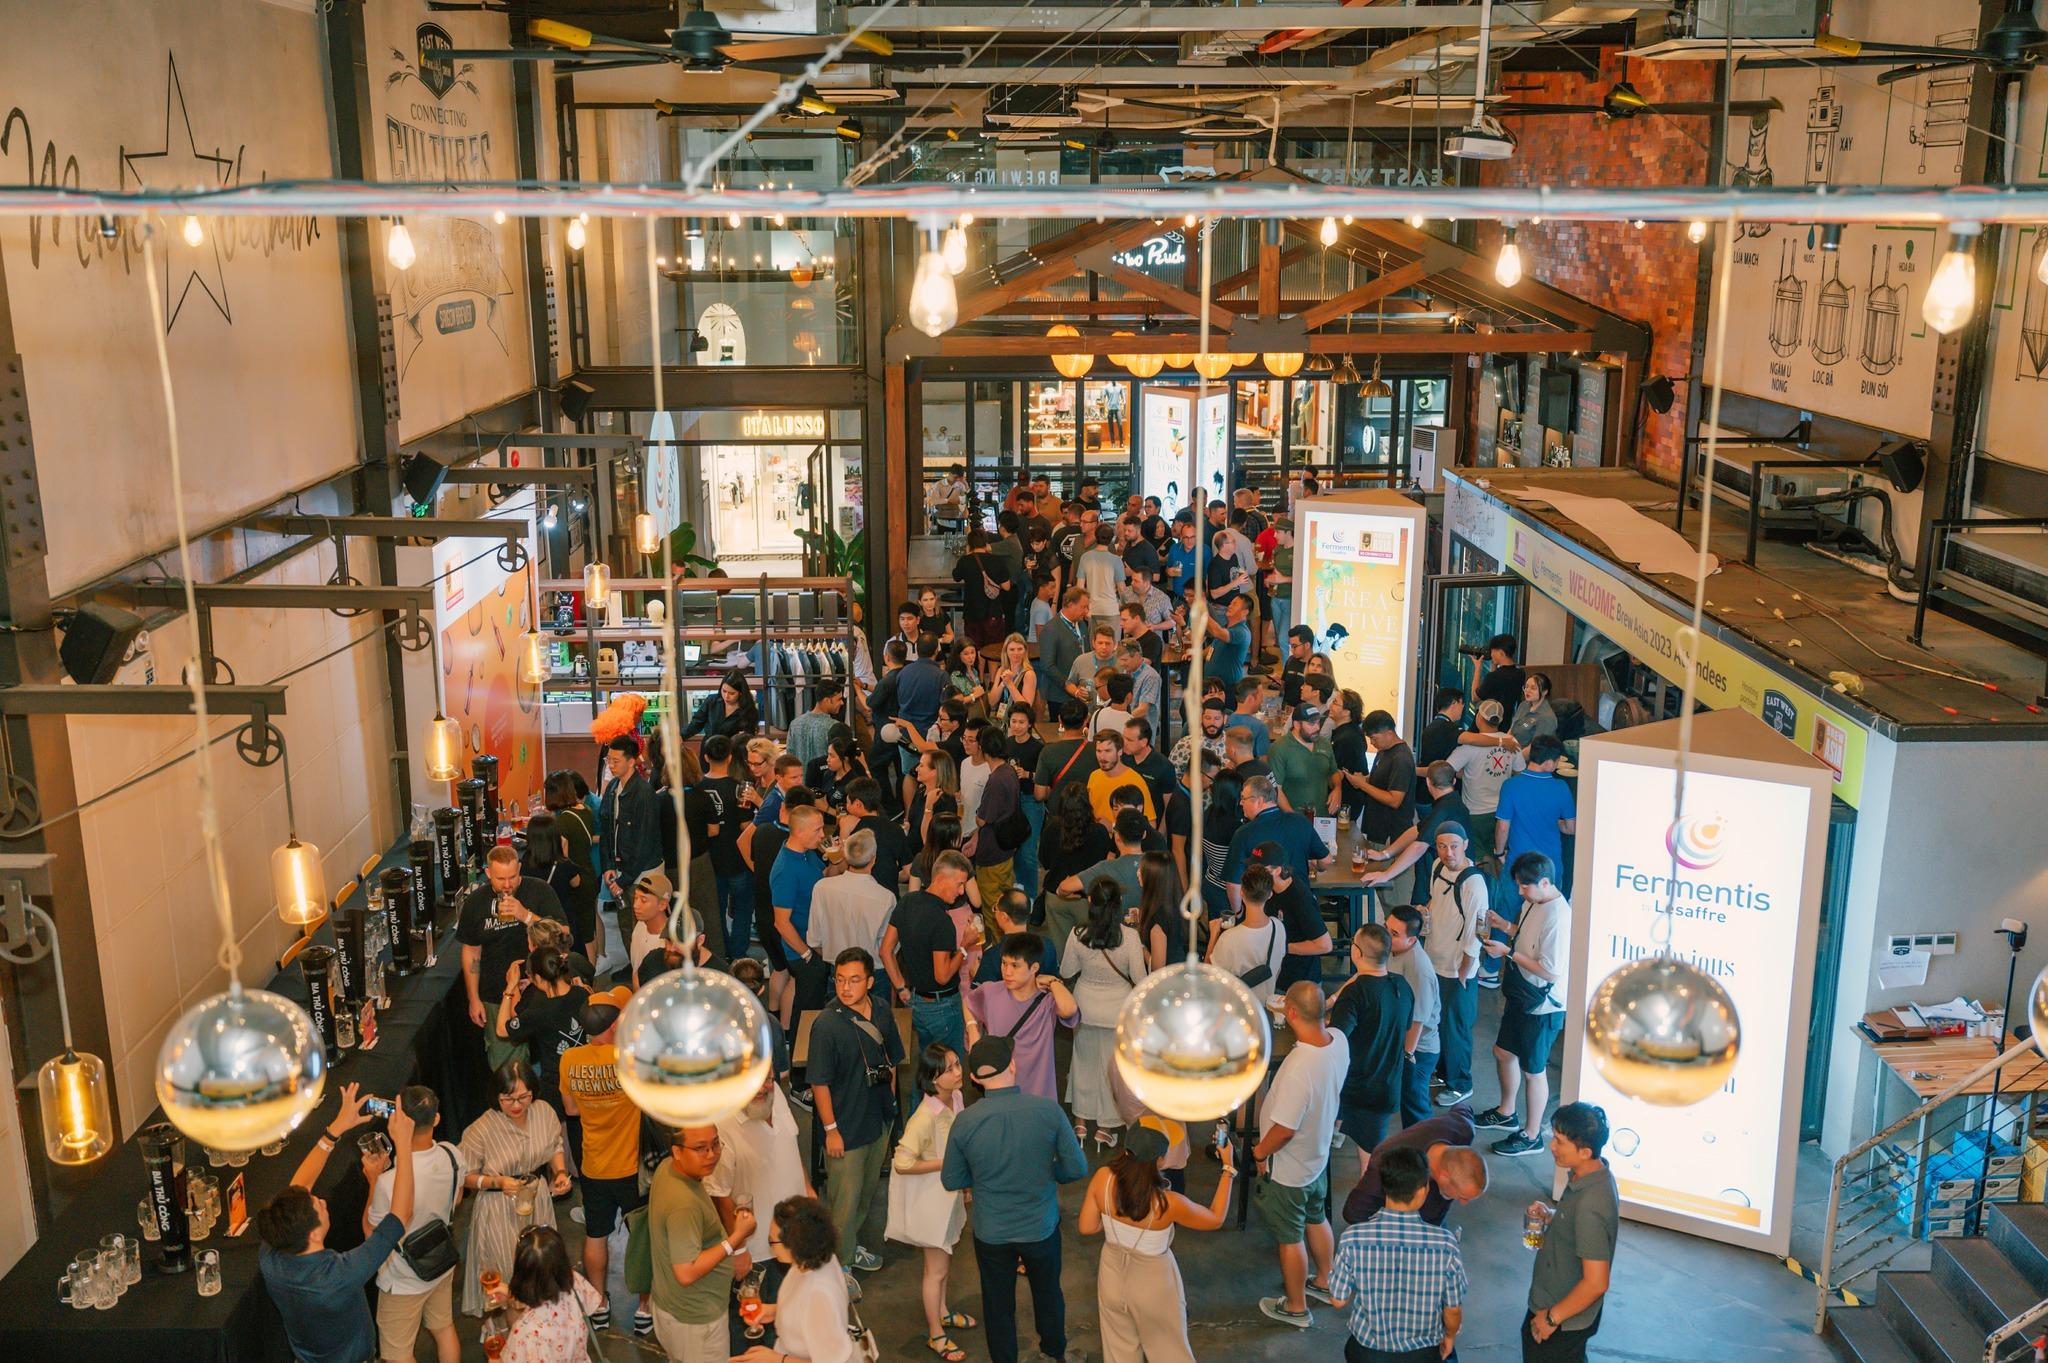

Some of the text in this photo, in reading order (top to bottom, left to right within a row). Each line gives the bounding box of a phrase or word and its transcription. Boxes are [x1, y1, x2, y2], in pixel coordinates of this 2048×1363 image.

[410, 103, 468, 128] CONNECTING
[385, 114, 492, 188] CULTURES
[1839, 137, 1853, 152] XAY
[845, 465, 861, 477] 164
[1321, 542, 1356, 552] Fermentis
[1344, 610, 1398, 633] TIVE
[1569, 569, 1728, 693] WELCOME Brew Asia 2023 Andees
[1766, 695, 1780, 707] EAST
[1779, 699, 1796, 720] WEST
[1615, 863, 1771, 912] Fermentis
[1654, 899, 1727, 923] Lesaffre
[1607, 933, 1736, 977] The ovious
[570, 1080, 624, 1094] BREWING
